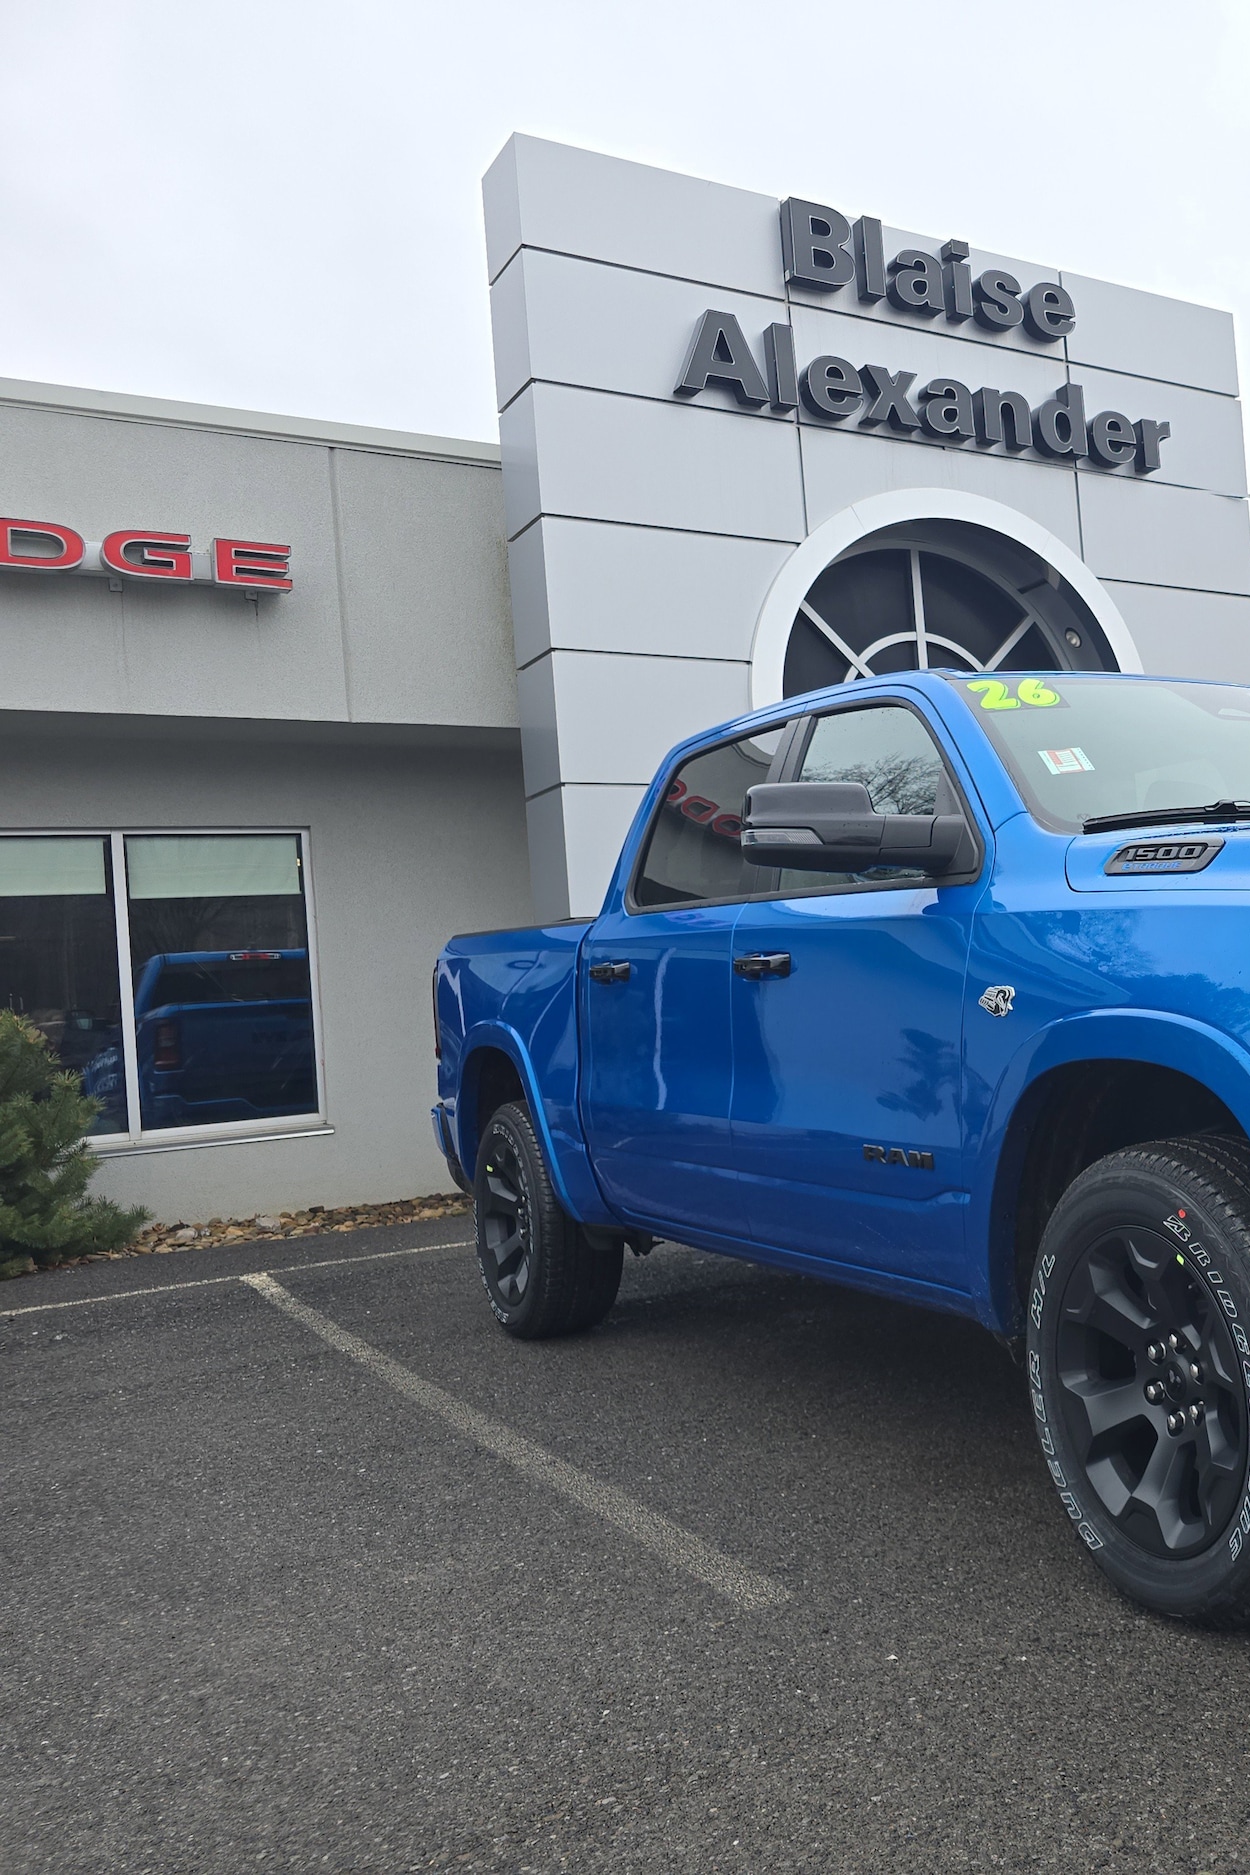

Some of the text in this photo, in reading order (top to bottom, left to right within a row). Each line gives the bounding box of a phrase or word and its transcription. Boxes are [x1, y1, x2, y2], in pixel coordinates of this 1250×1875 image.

[780, 196, 1076, 342] Blaise
[674, 309, 1171, 473] Alexander
[966, 678, 1060, 710] 26
[1125, 845, 1203, 860] 1500
[863, 1143, 935, 1171] RAM
[1029, 1350, 1104, 1551] DUELER
